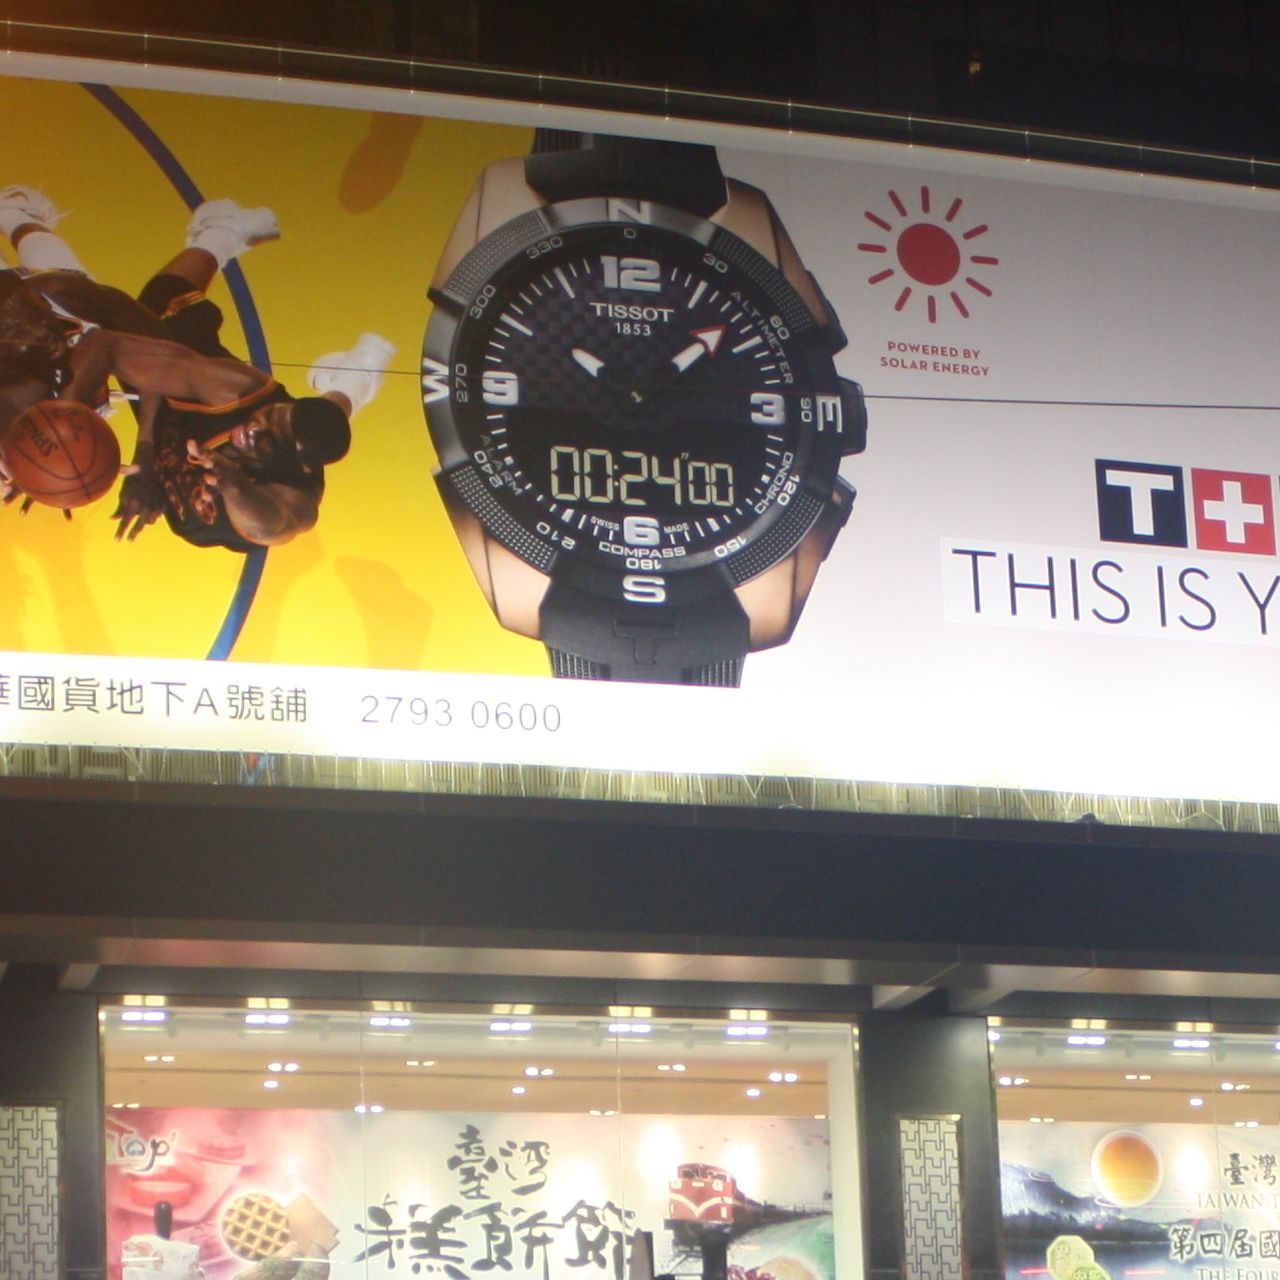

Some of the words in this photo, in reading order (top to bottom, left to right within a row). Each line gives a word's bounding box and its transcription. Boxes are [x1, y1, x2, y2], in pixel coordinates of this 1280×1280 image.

[525, 236, 564, 259] 330
[703, 252, 729, 274] 30
[600, 255, 662, 292] 12
[470, 284, 496, 320] 300
[589, 302, 675, 323] TISSOT
[615, 322, 652, 337] 1853
[729, 289, 795, 385] ALTIMETER
[770, 314, 791, 341] 60
[879, 356, 928, 374] SOLAR
[933, 359, 990, 378] ENERGY
[886, 340, 958, 360] POWERED
[962, 346, 981, 361] BY
[456, 362, 469, 403] 270
[481, 370, 519, 406] 9
[750, 392, 787, 426] 3
[481, 434, 523, 497] ALARM
[754, 451, 794, 516] CHRONO
[777, 474, 800, 507] 120
[1106, 468, 1176, 536] T
[590, 515, 620, 532] SWISS
[663, 521, 690, 535] MADE
[623, 516, 660, 546] 6
[598, 541, 687, 559] COMPASS
[951, 548, 1131, 626] THIS
[1157, 565, 1218, 632] IS
[360, 694, 454, 728] 2793
[471, 701, 563, 733] 0600
[447, 1124, 551, 1200] 臺灣
[1195, 1191, 1264, 1211] TAIWAN
